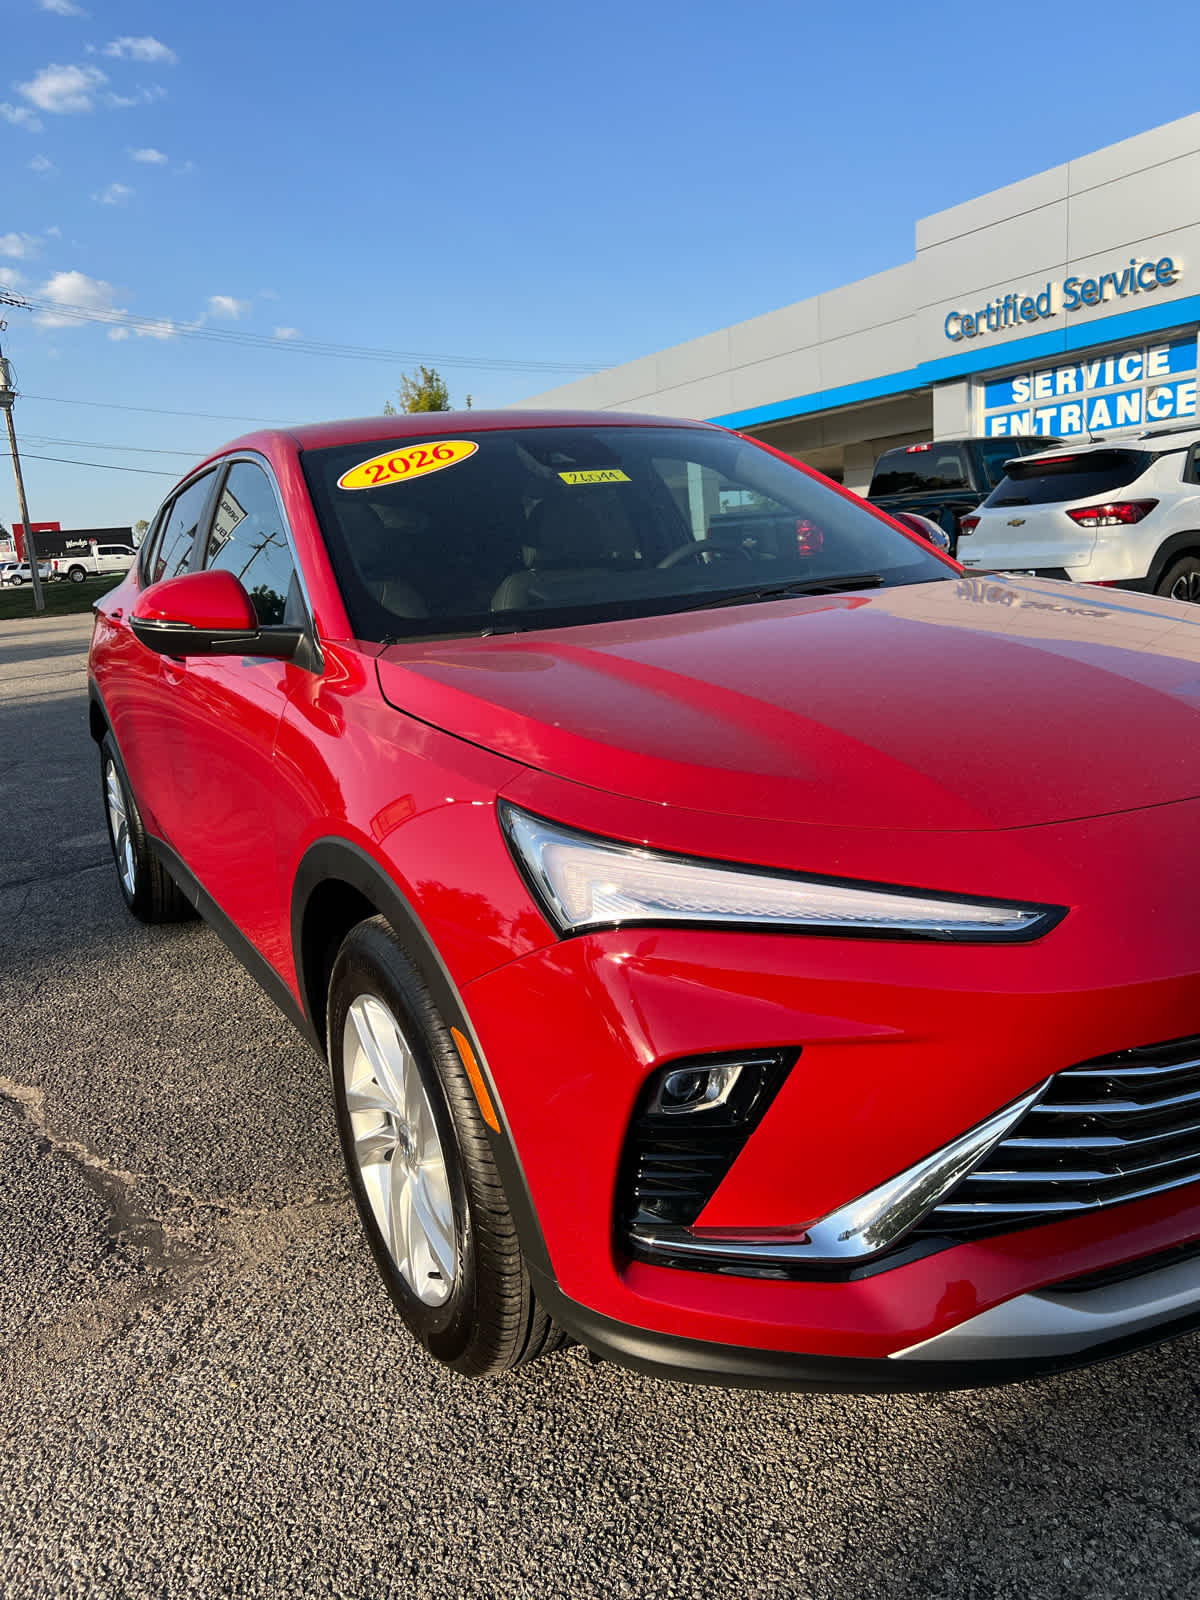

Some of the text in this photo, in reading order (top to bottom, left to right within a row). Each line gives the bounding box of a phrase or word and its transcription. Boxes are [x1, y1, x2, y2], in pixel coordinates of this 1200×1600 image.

[944, 256, 1175, 341] Certified Service
[1011, 344, 1171, 403] SERVICE
[990, 382, 1198, 437] ENTRANCE
[365, 443, 454, 483] 2026
